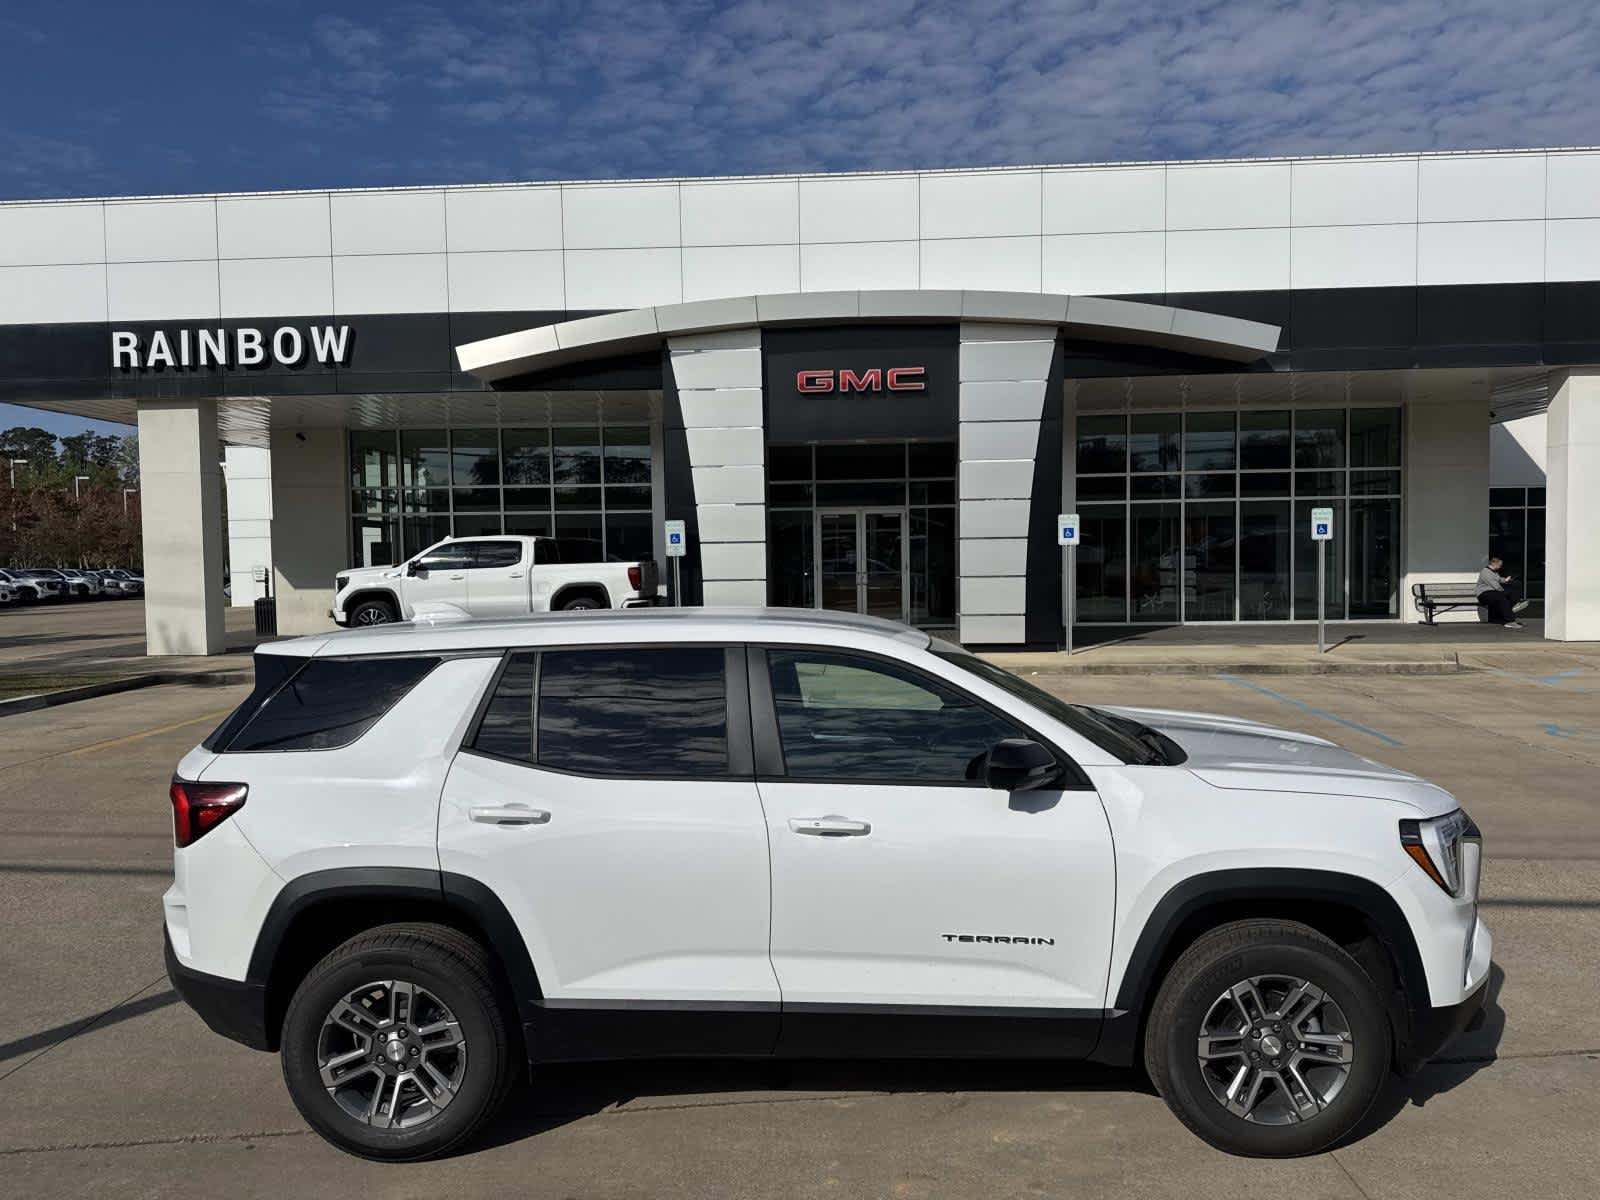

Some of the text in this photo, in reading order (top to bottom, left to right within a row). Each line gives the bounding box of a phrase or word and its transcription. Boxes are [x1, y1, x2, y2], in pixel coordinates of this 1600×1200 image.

[111, 325, 349, 368] RAINBOW
[796, 366, 925, 393] GMC
[941, 934, 1055, 946] TERRAIN
